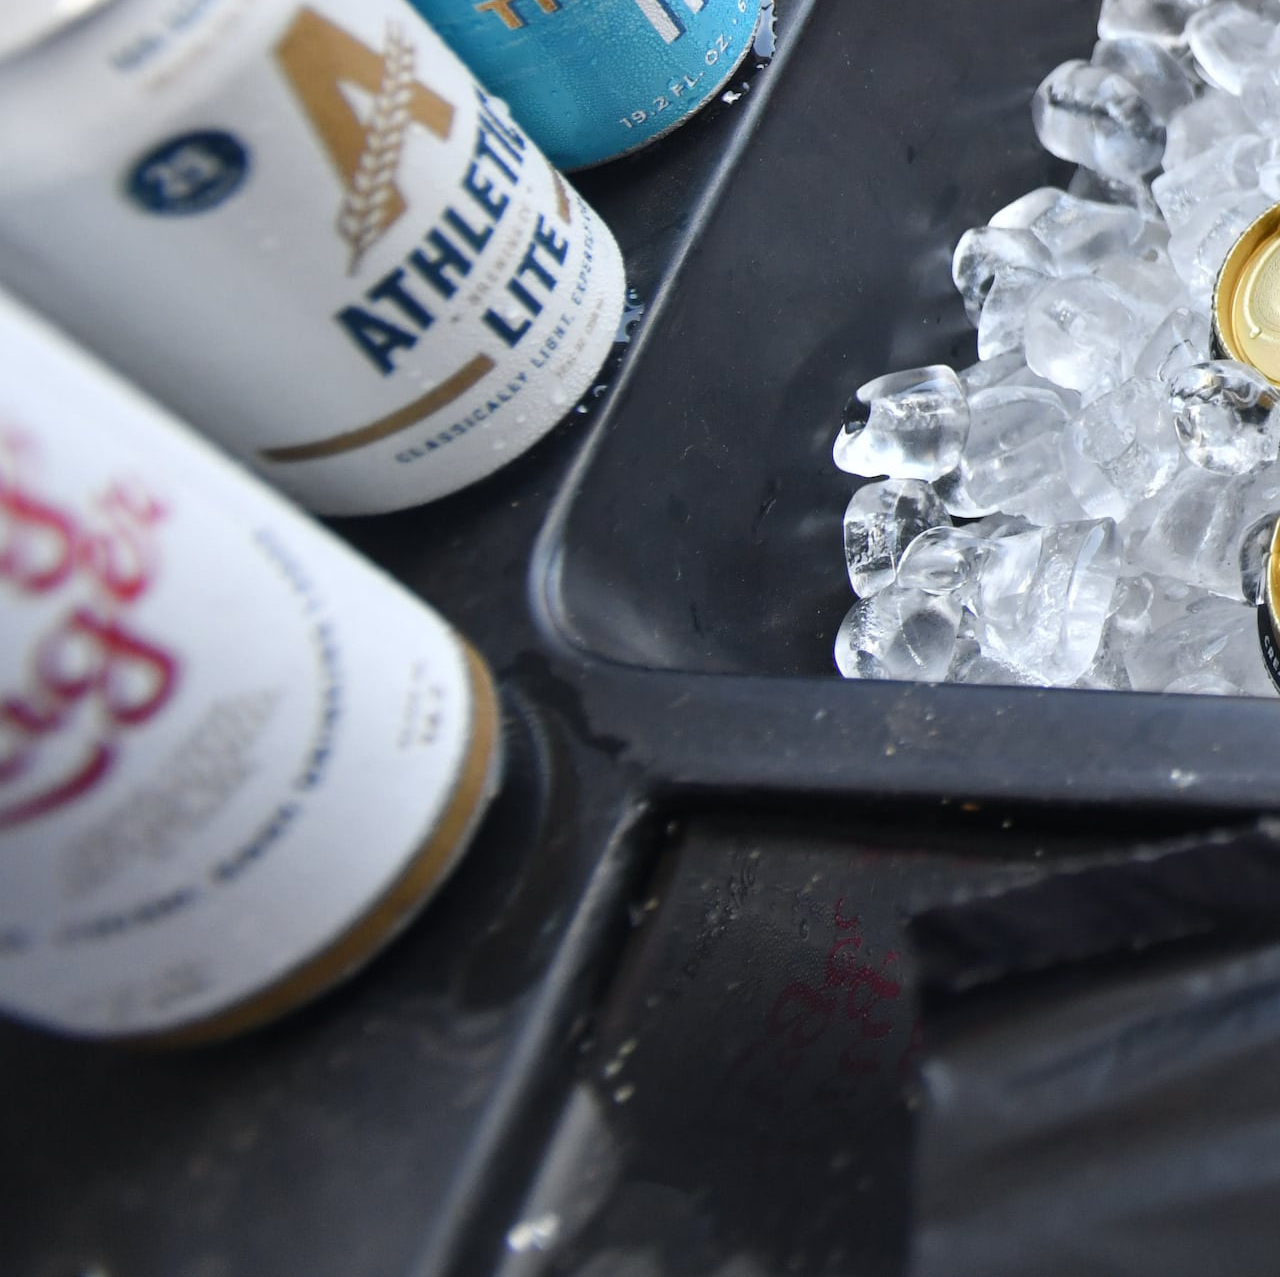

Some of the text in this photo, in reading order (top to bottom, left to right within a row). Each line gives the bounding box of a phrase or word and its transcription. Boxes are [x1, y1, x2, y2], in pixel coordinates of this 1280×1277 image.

[618, 33, 735, 129] 19.2 FL. OZ.
[481, 211, 570, 349] LITE
[394, 371, 528, 464] CLASSICALLY
